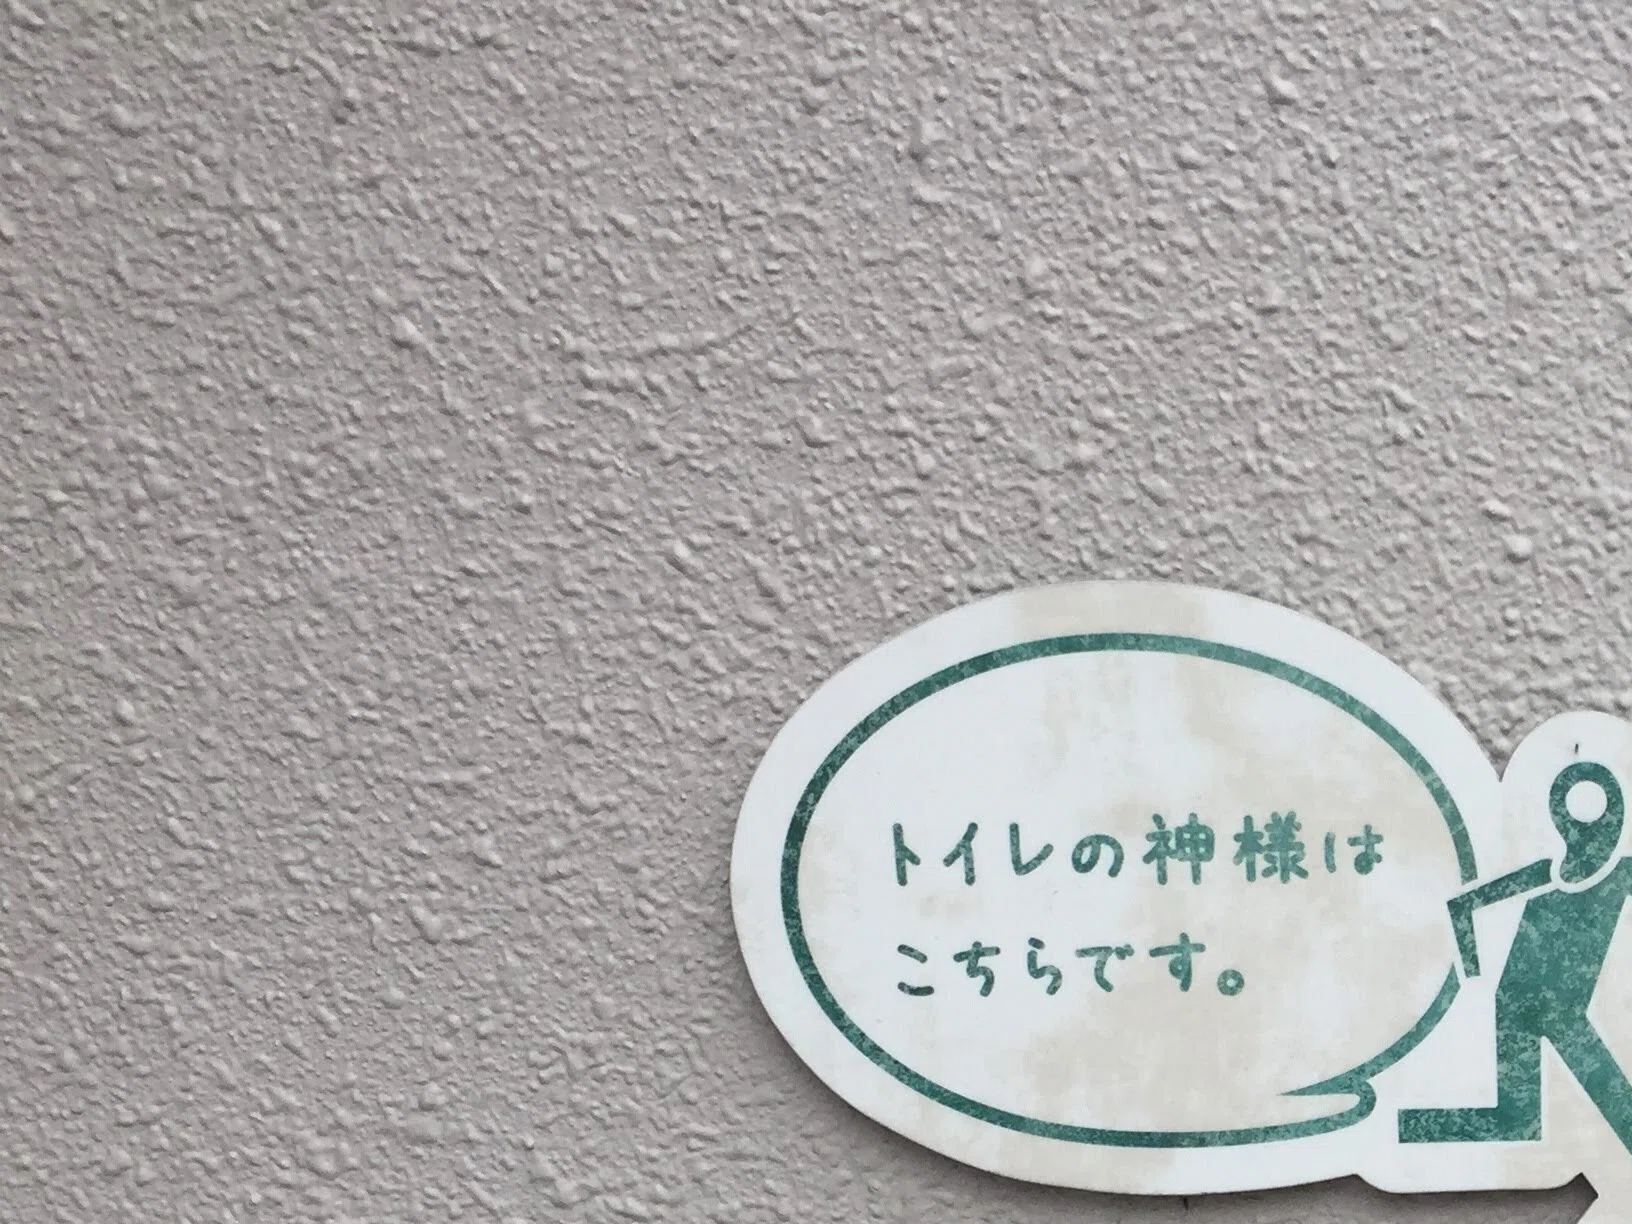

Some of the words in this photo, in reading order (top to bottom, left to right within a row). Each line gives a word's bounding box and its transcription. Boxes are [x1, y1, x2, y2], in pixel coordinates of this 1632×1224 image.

[892, 810, 1385, 887] トイレの神様は
[896, 931, 1247, 998] こちらです。
